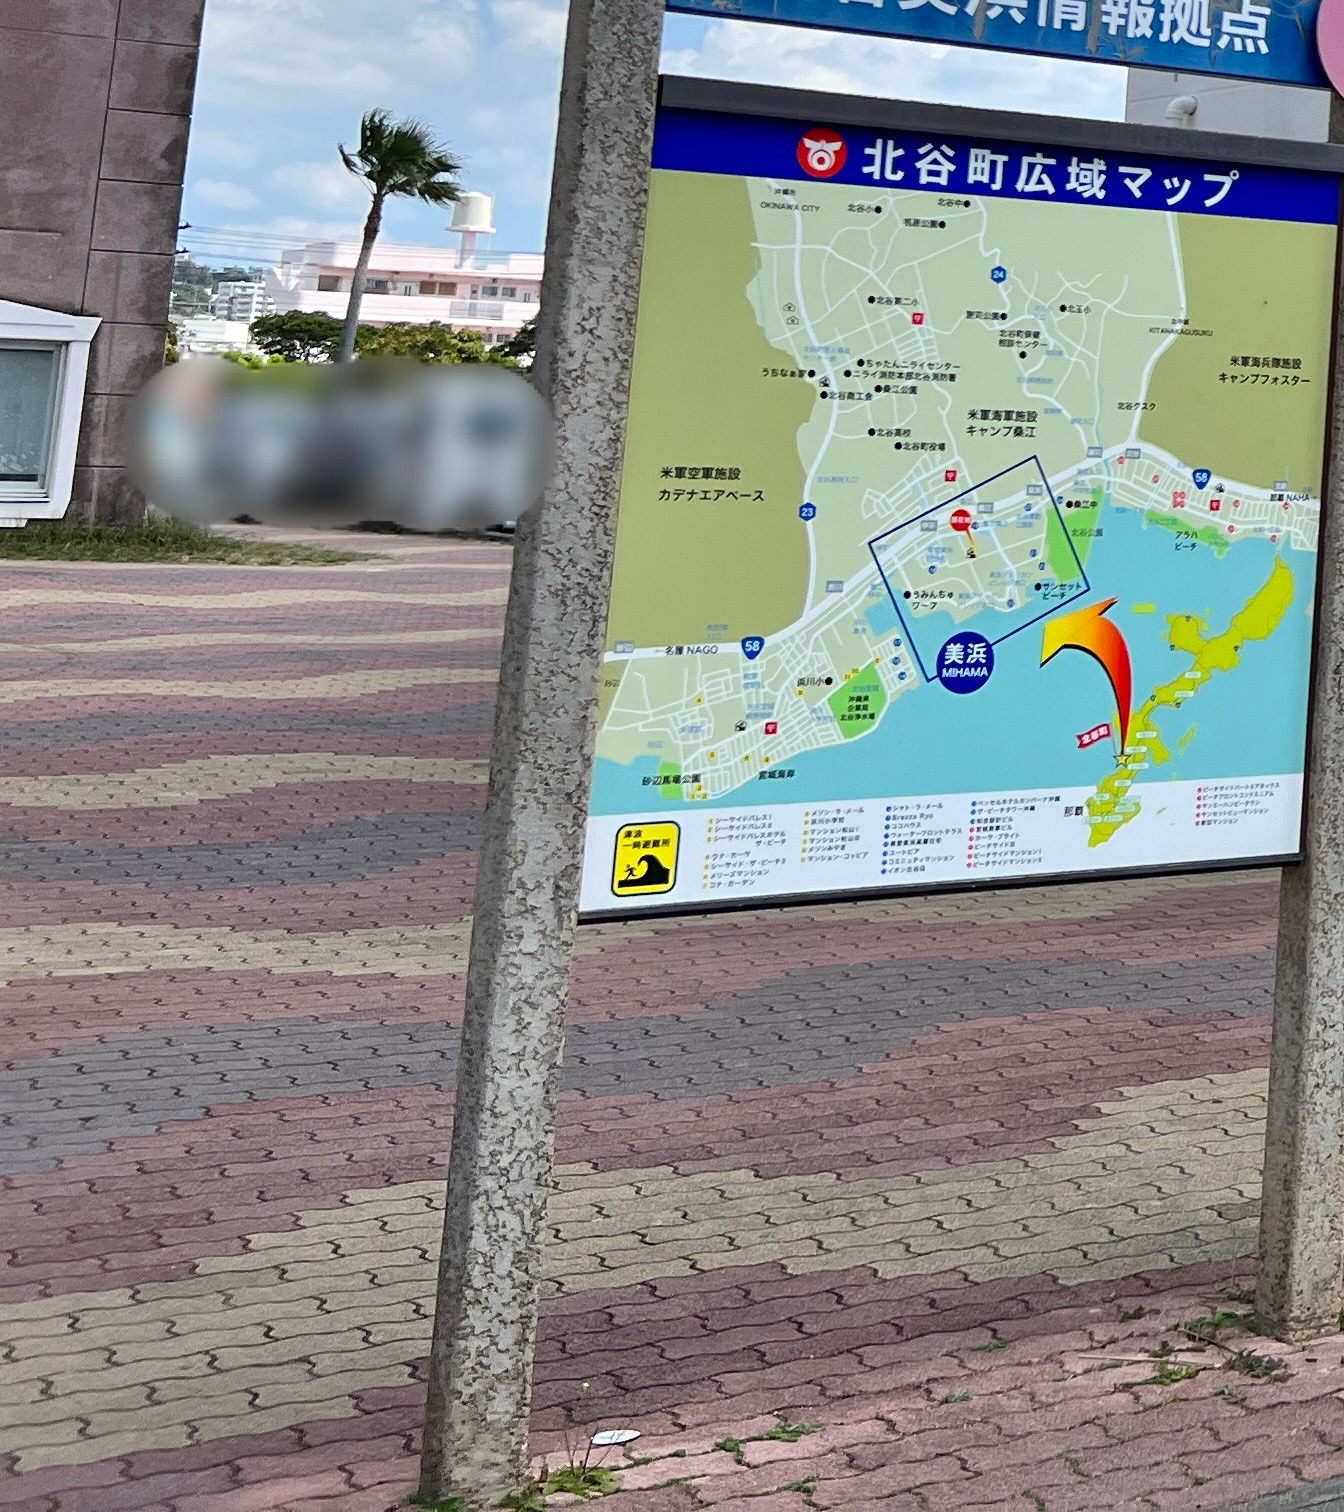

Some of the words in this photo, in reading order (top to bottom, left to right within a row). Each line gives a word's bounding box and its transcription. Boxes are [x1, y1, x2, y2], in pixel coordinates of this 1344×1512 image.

[862, 138, 1240, 208] 北谷町広域マップ
[760, 201, 799, 212] OKINAWA
[801, 204, 820, 212] CITY
[992, 270, 1005, 280] 24
[1230, 356, 1302, 369] 米軍海兵隊施設
[1218, 373, 1310, 385] キャンプフォスター
[968, 410, 1038, 423] 米軍海軍施設
[966, 425, 1036, 438] キャンプ桑江
[660, 467, 741, 481] 米軍空軍施設
[1194, 472, 1208, 483] 58
[658, 489, 764, 502] カデナエアベース
[801, 507, 813, 516] 23
[686, 645, 718, 655] NAGO
[745, 640, 760, 651] 58
[944, 643, 987, 664] 美浜
[942, 666, 989, 678] MIHAMA
